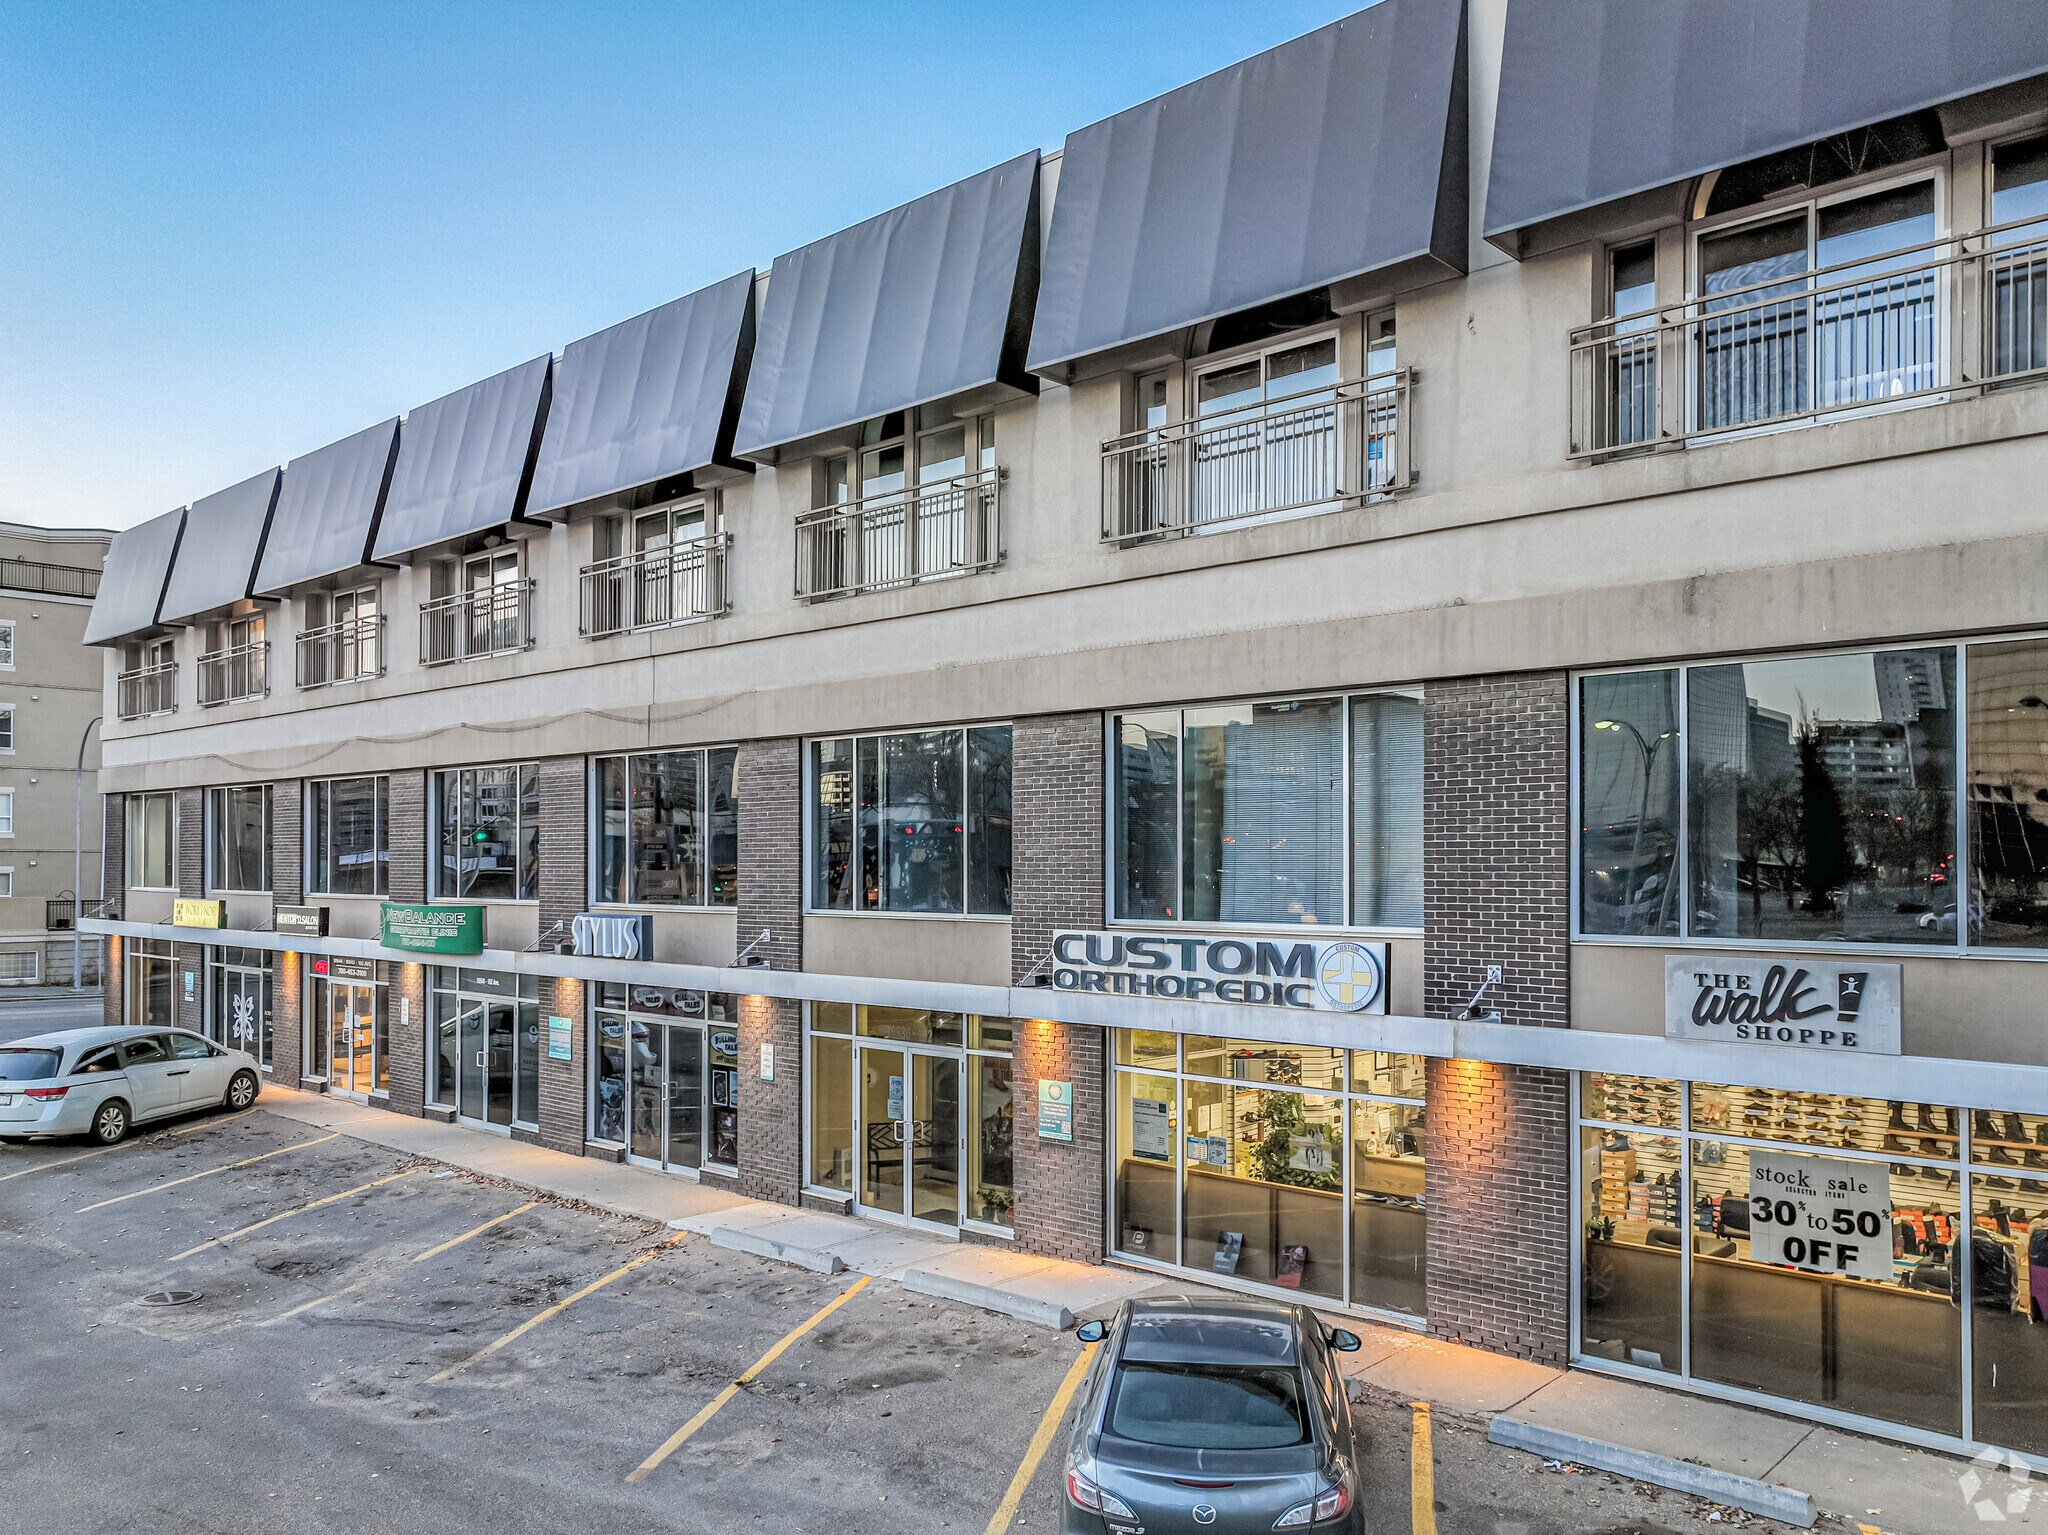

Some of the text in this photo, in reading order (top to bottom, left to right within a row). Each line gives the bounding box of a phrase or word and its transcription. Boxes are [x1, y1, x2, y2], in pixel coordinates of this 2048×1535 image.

[431, 928, 458, 937] CLINIC
[571, 916, 639, 960] STYLUS
[1053, 934, 1315, 979] CUSTOM
[1335, 944, 1360, 953] CUSTOM
[1053, 968, 1314, 1009] ORTHOPEDIC
[1694, 973, 1751, 990] THE
[684, 1001, 701, 1009] TALES
[1736, 1024, 1857, 1047] SHOPPE
[1755, 1167, 1868, 1194] stock sale
[1807, 1212, 1828, 1230] to
[1783, 1236, 1859, 1270] OFF
